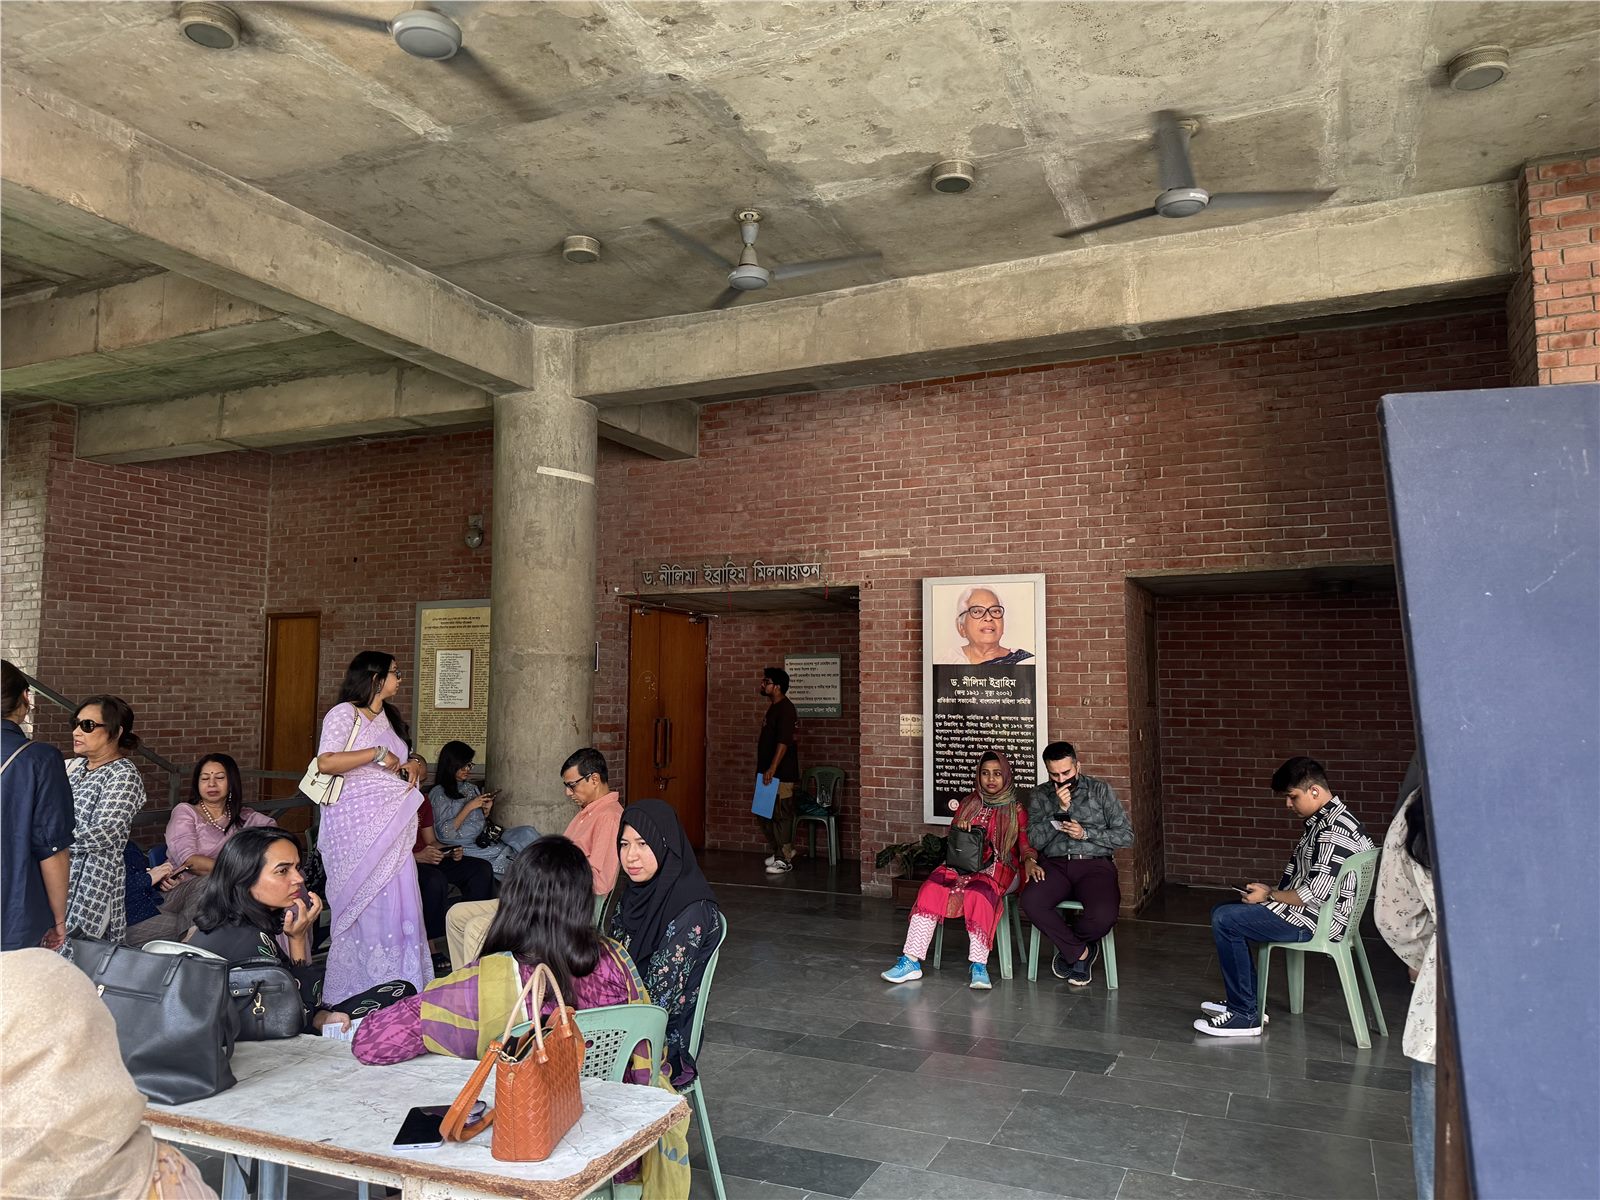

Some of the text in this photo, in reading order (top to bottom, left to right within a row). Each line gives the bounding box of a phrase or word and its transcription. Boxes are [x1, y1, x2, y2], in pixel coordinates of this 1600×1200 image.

[642, 559, 821, 586] ড. নীলিমা ইব্রাহিম মিলনায়তন
[950, 676, 1016, 689] ড. নীলিমা ইব্রাহিম
[996, 689, 1013, 697] ২০০২)
[1001, 697, 1016, 705] মহিলা
[1016, 697, 1032, 705] সমিতি
